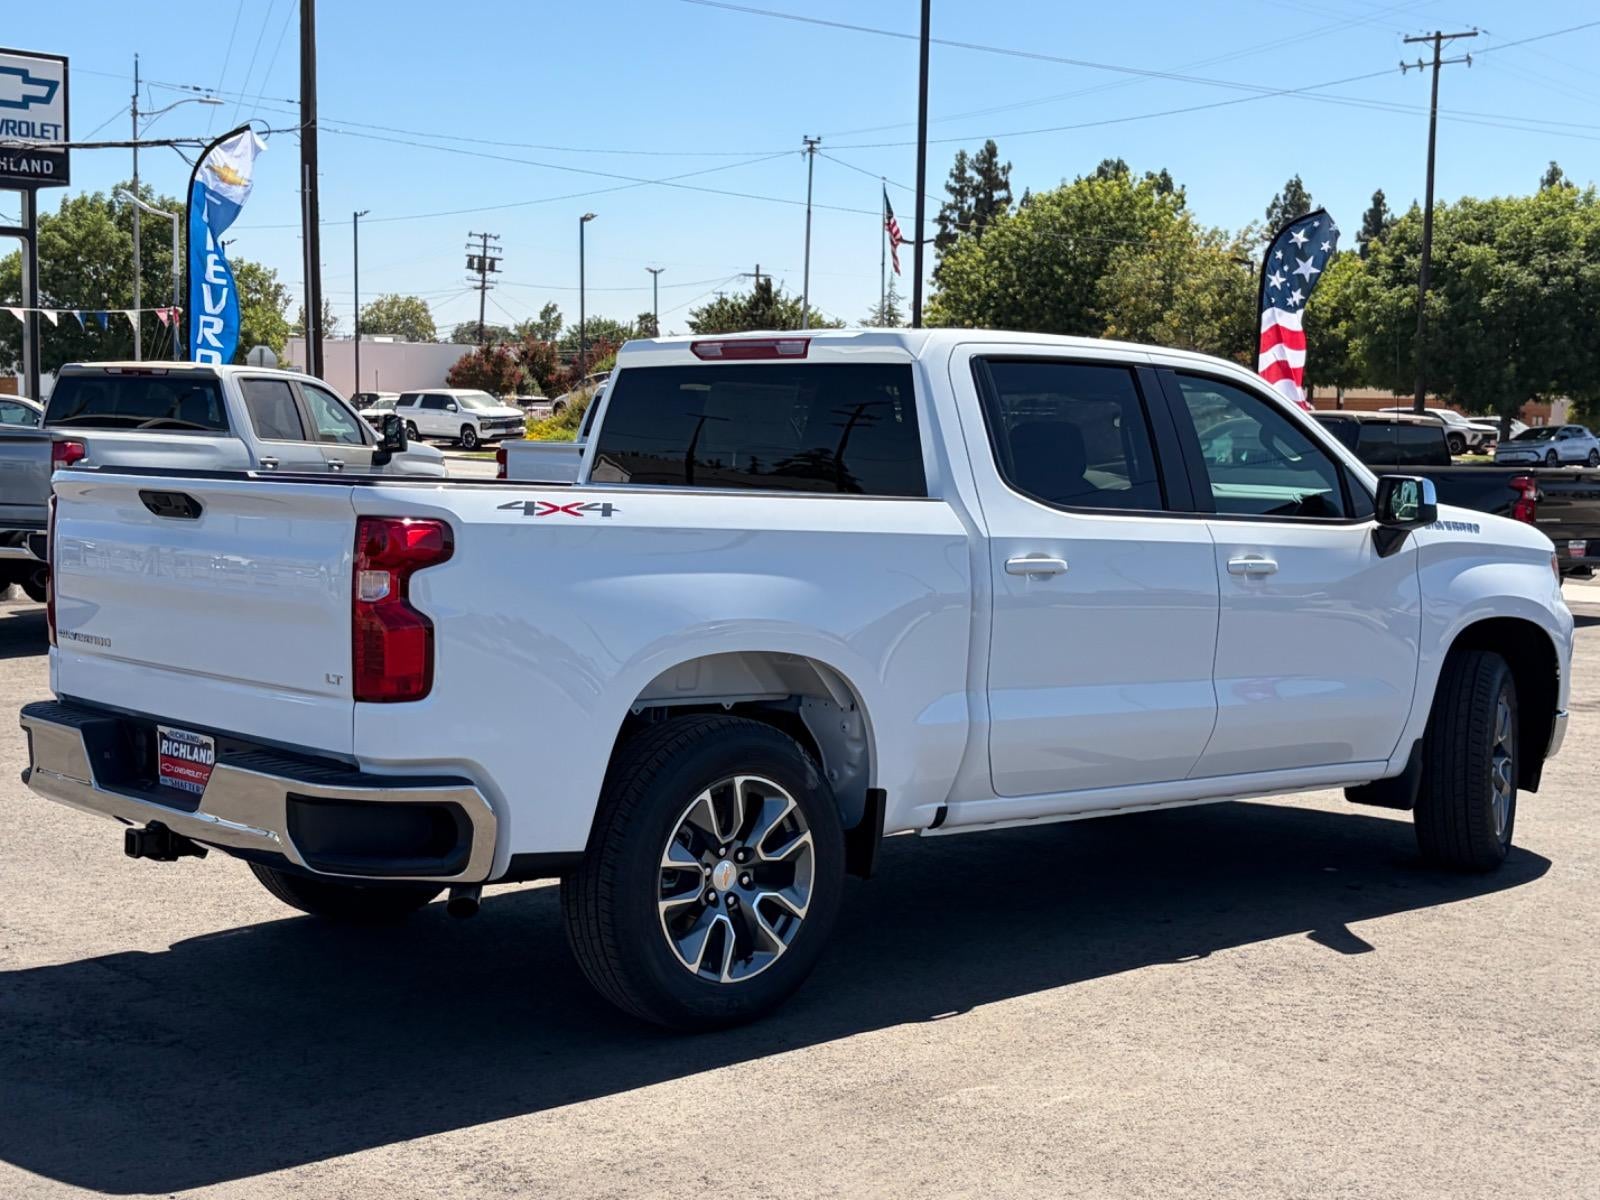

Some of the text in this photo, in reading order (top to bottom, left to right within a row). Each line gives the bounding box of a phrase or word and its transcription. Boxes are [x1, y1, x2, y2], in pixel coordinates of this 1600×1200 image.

[497, 501, 621, 517] 4X4
[326, 673, 343, 686] LT
[161, 739, 213, 765] RICHLAND
